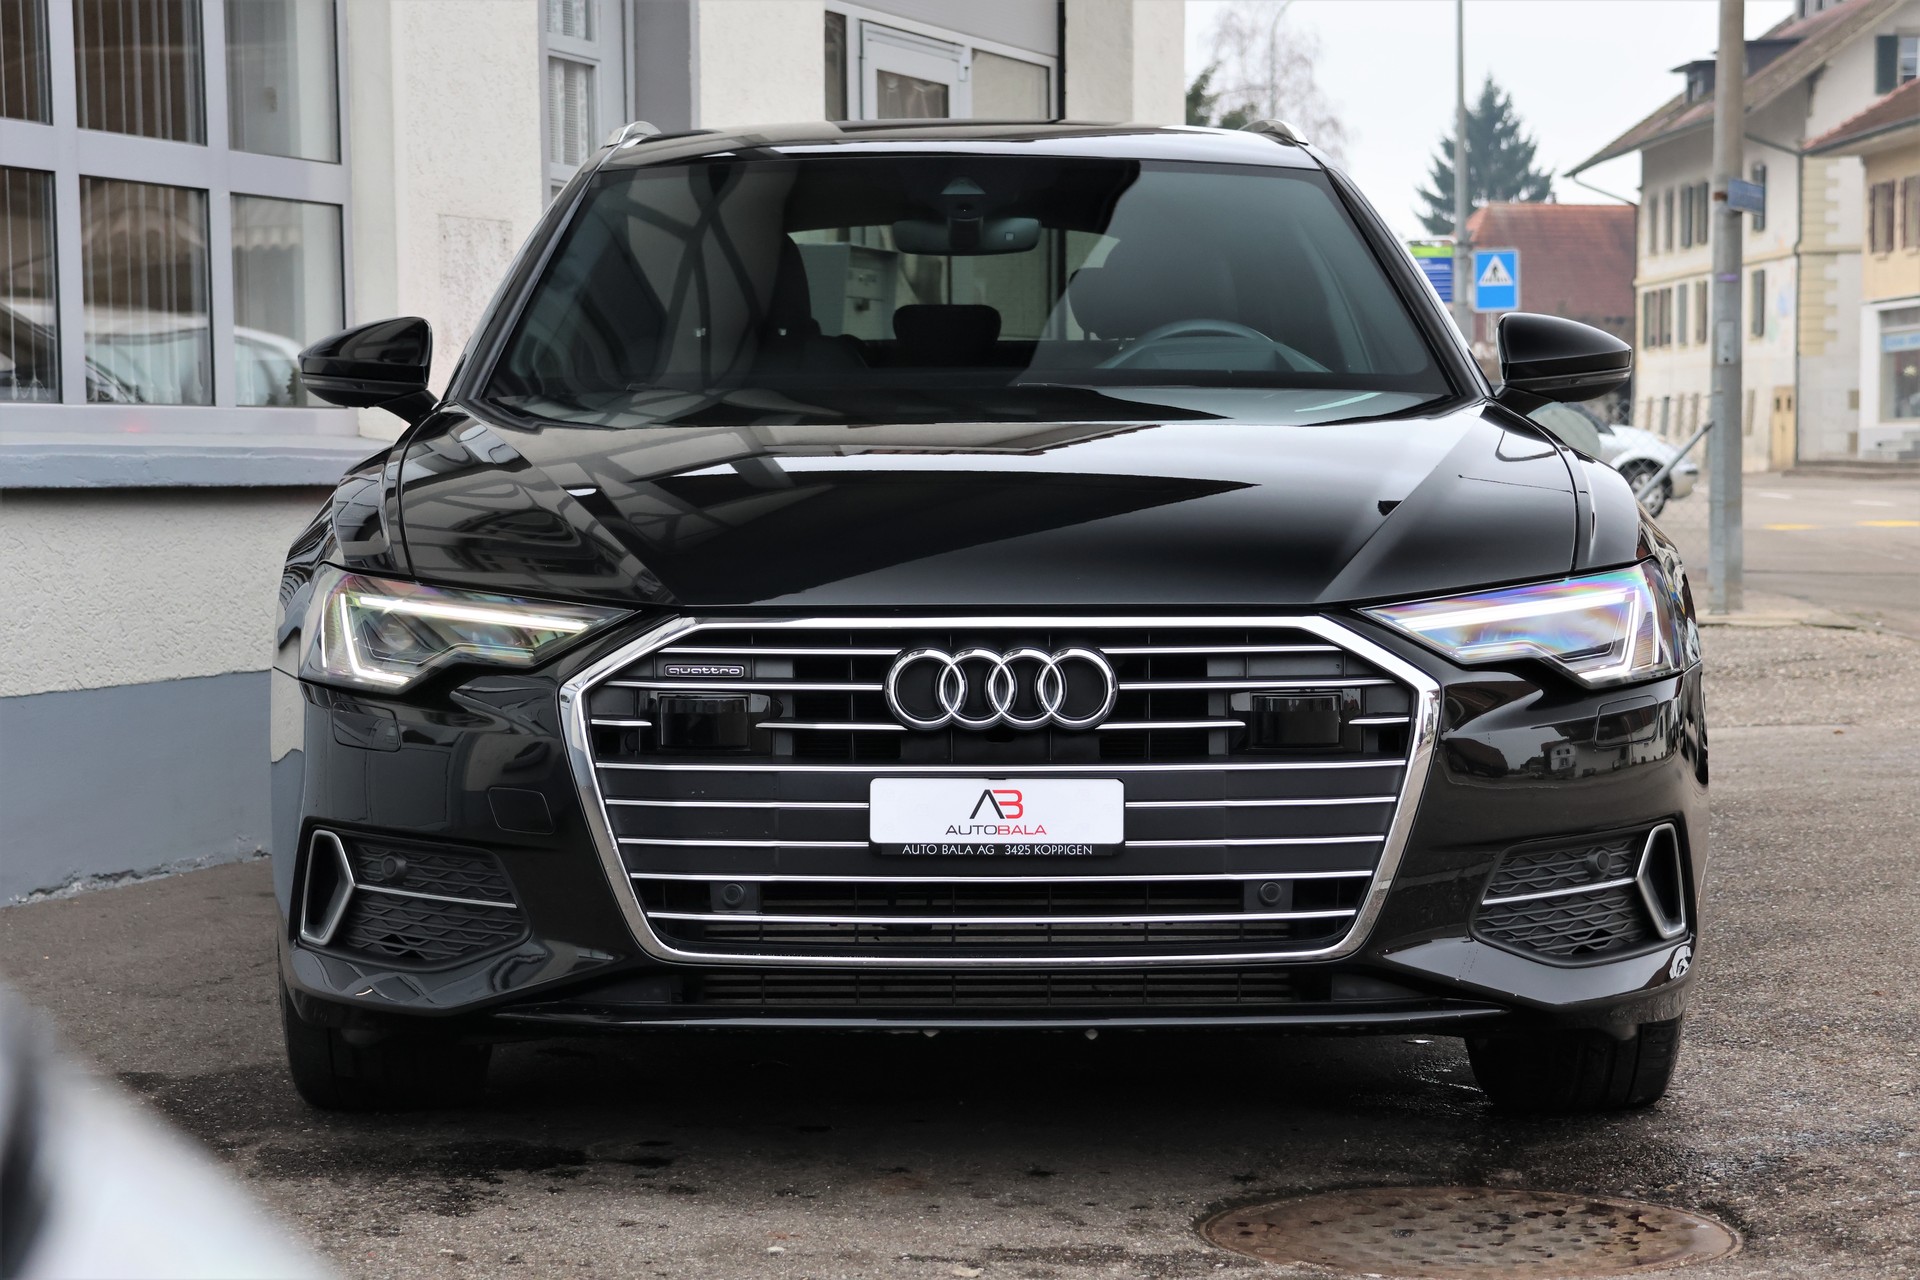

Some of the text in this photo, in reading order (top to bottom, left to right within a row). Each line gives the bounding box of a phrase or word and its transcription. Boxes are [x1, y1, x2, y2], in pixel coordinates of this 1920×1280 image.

[667, 666, 741, 675] quattro
[945, 825, 1047, 835] AUTOBALA
[902, 844, 1093, 855] AUTO BALA AG 3425 KOPPIGEN
